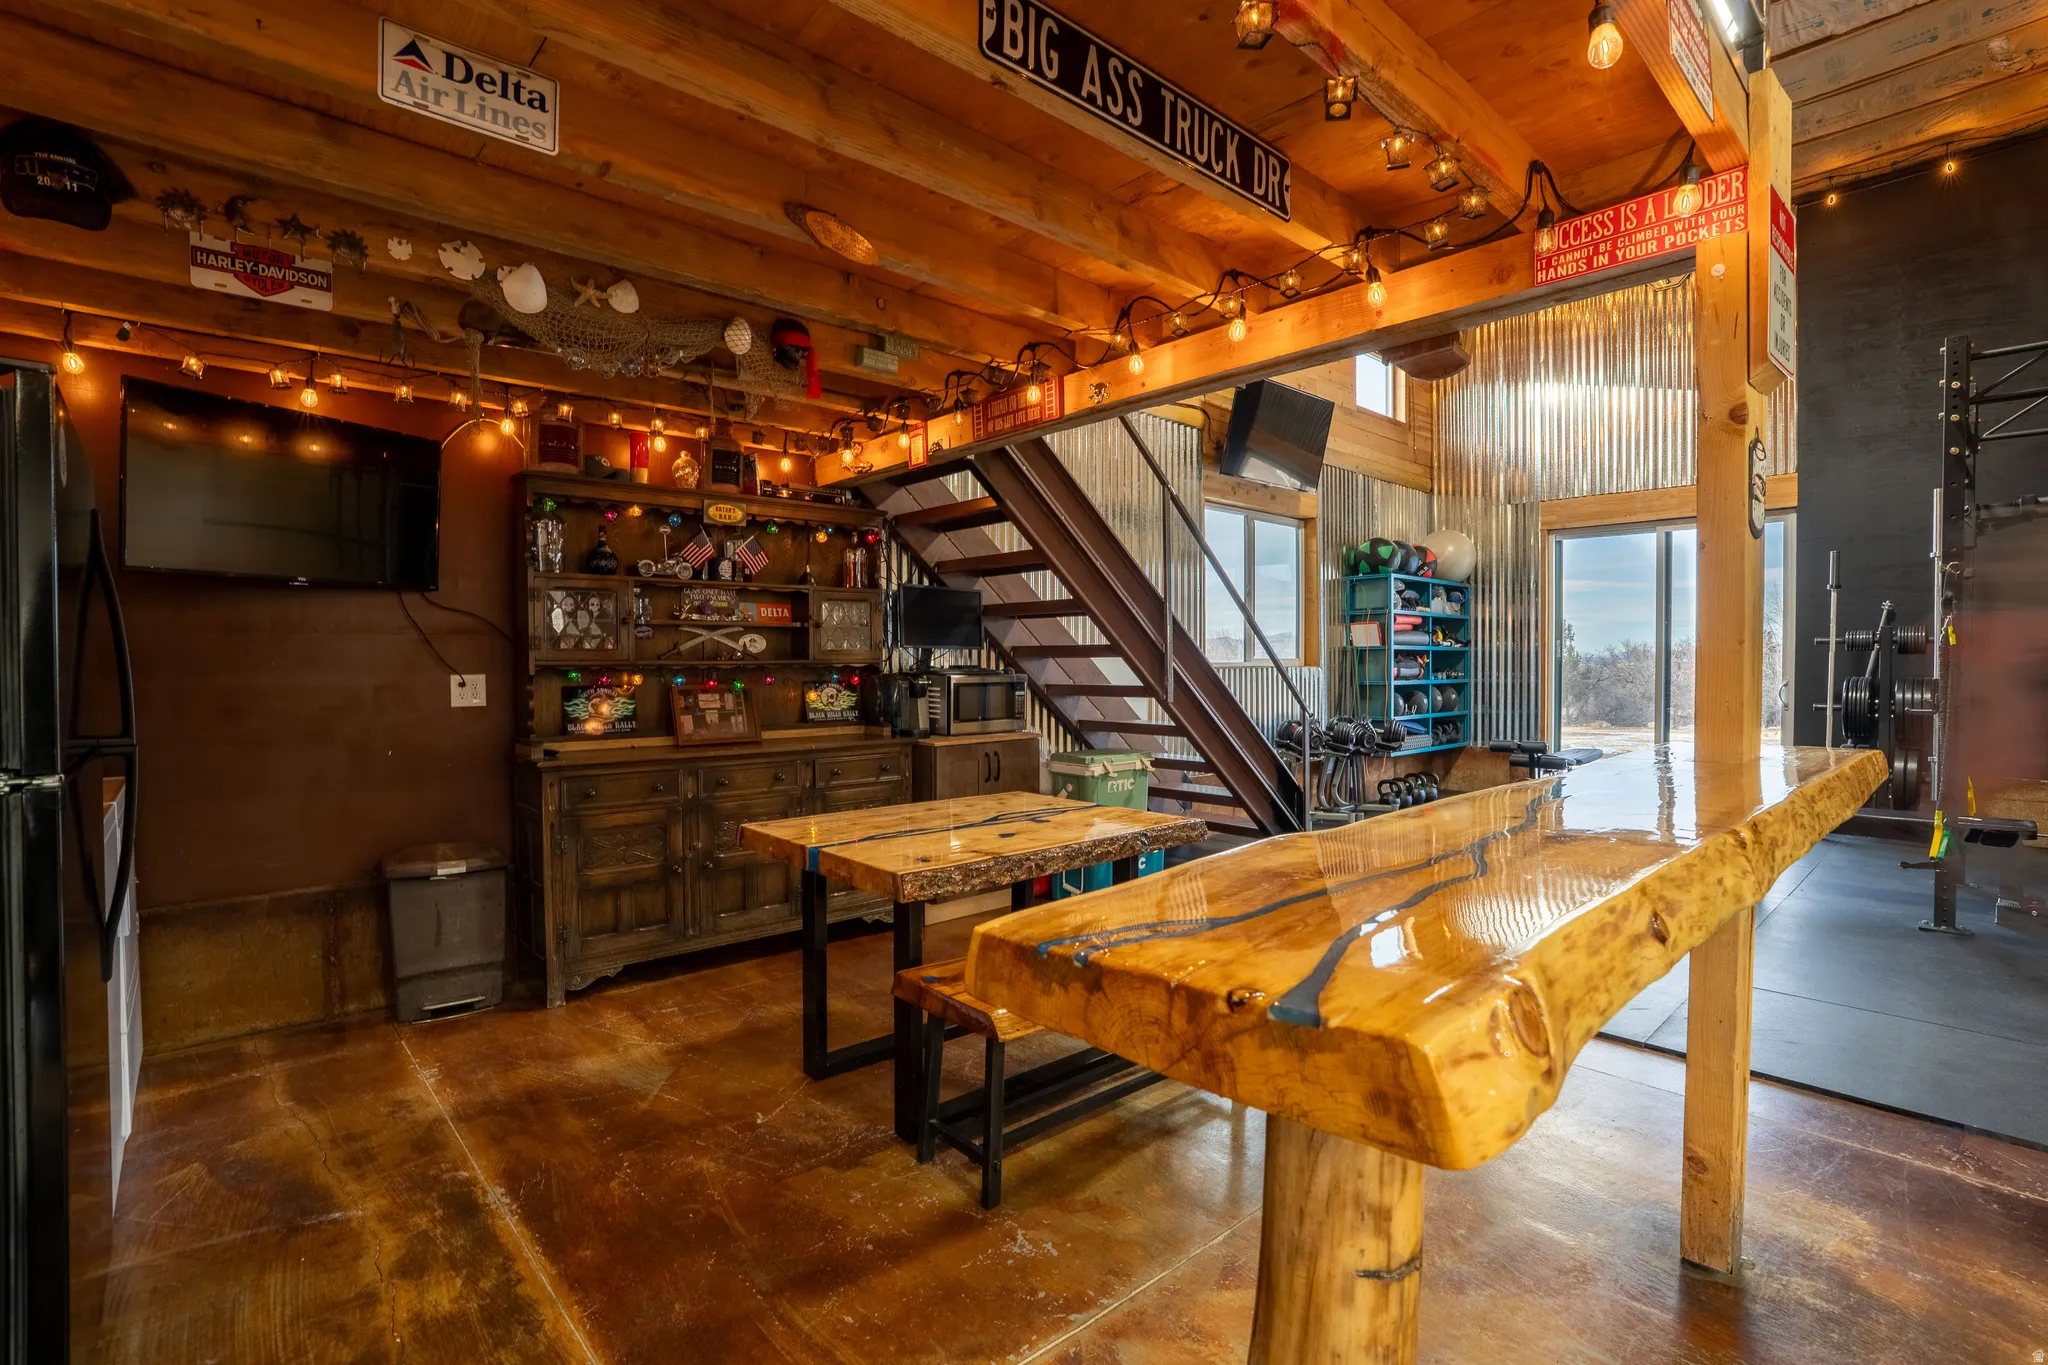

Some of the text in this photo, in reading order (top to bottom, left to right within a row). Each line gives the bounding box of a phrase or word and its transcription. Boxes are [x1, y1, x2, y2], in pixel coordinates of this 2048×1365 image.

[441, 50, 549, 113] Delta
[1003, 0, 1281, 207] BIG ASS TRUCK DR
[1620, 202, 1637, 231] IS
[1644, 197, 1657, 225] A
[1537, 204, 1745, 270] IT CANNOT BE CLIMBED WITH YOUR
[1537, 216, 1746, 283] HANDS IN YOUR POCKETS
[196, 250, 328, 288] HARLEY-DAVIDSON
[718, 513, 732, 521] BAR
[690, 593, 705, 601] TWO
[760, 607, 790, 618] DELTA
[615, 720, 636, 728] RALLY
[1107, 778, 1135, 793] RTIC
